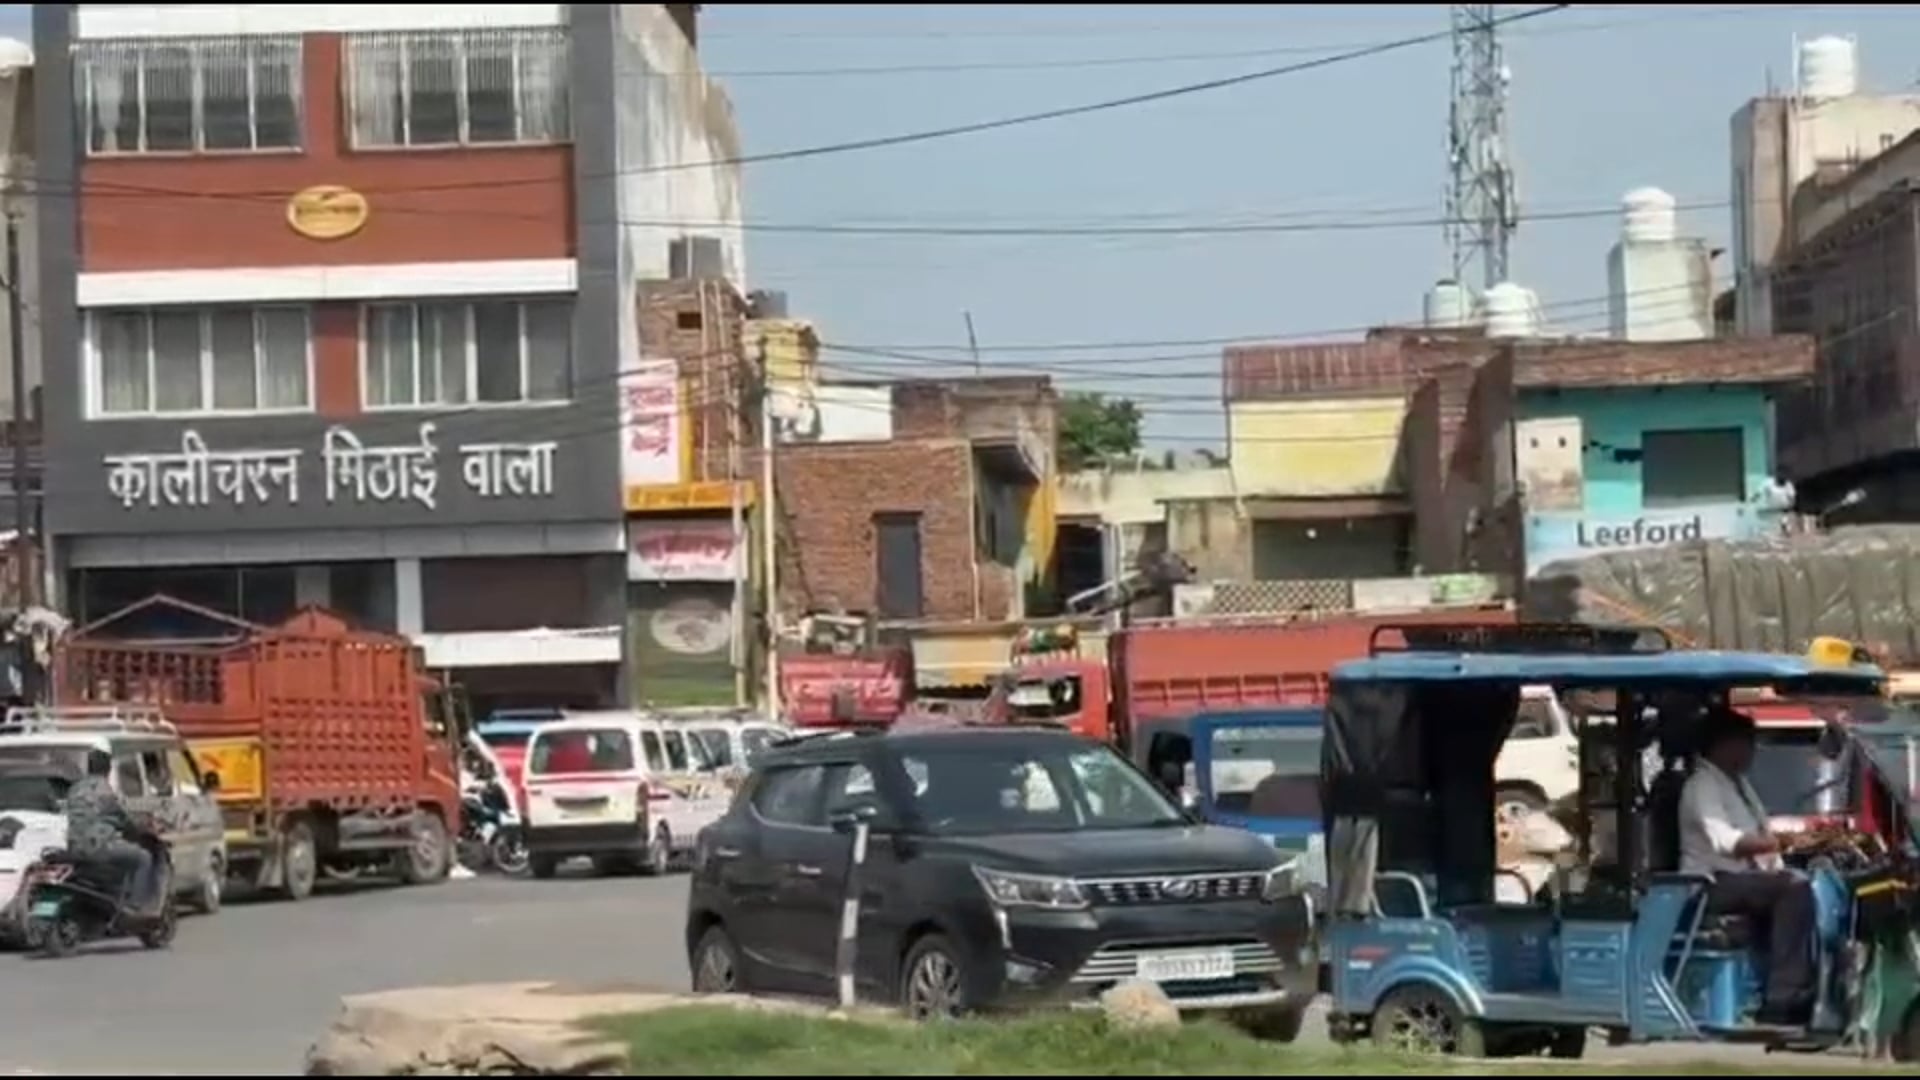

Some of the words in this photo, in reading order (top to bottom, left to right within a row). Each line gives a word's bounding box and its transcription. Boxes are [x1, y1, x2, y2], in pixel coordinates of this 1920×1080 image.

[104, 429, 303, 506] कालीचरन
[322, 422, 438, 509] मिठाई
[459, 441, 558, 495] वाला
[1576, 515, 1702, 548] Leeford
